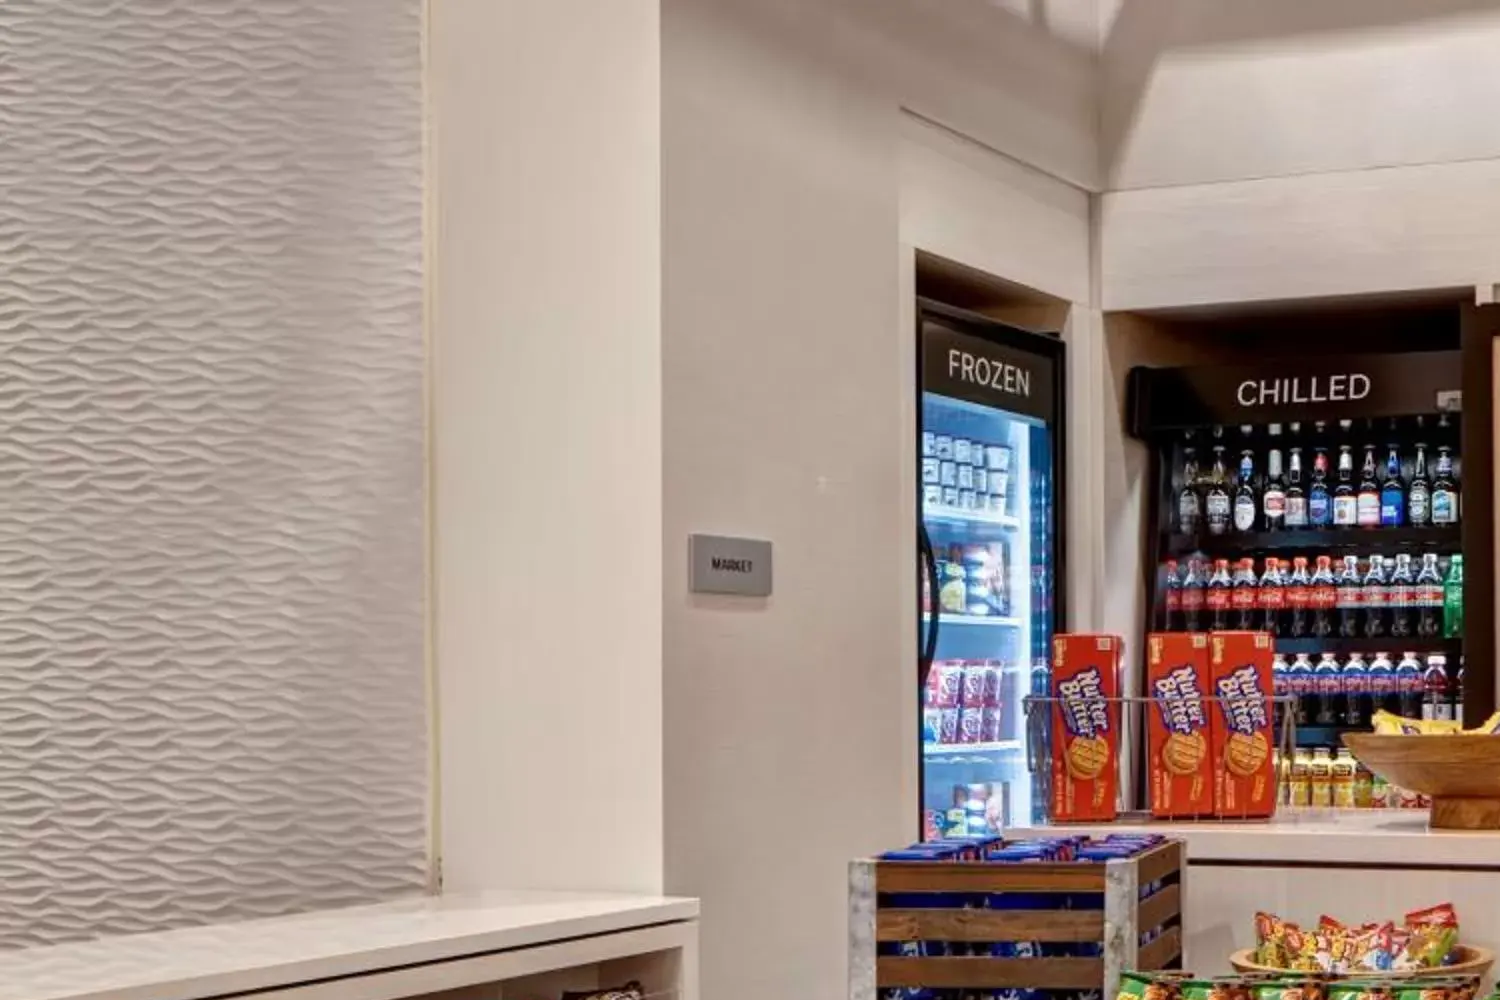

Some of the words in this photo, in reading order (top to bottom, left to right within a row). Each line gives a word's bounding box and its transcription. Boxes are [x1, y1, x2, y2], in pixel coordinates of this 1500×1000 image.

[948, 349, 1031, 397] FROZEN
[1236, 373, 1371, 407] CHILLED
[1077, 668, 1108, 730] Nutter
[1172, 665, 1204, 725] Nutter
[1234, 665, 1267, 726] Nutter
